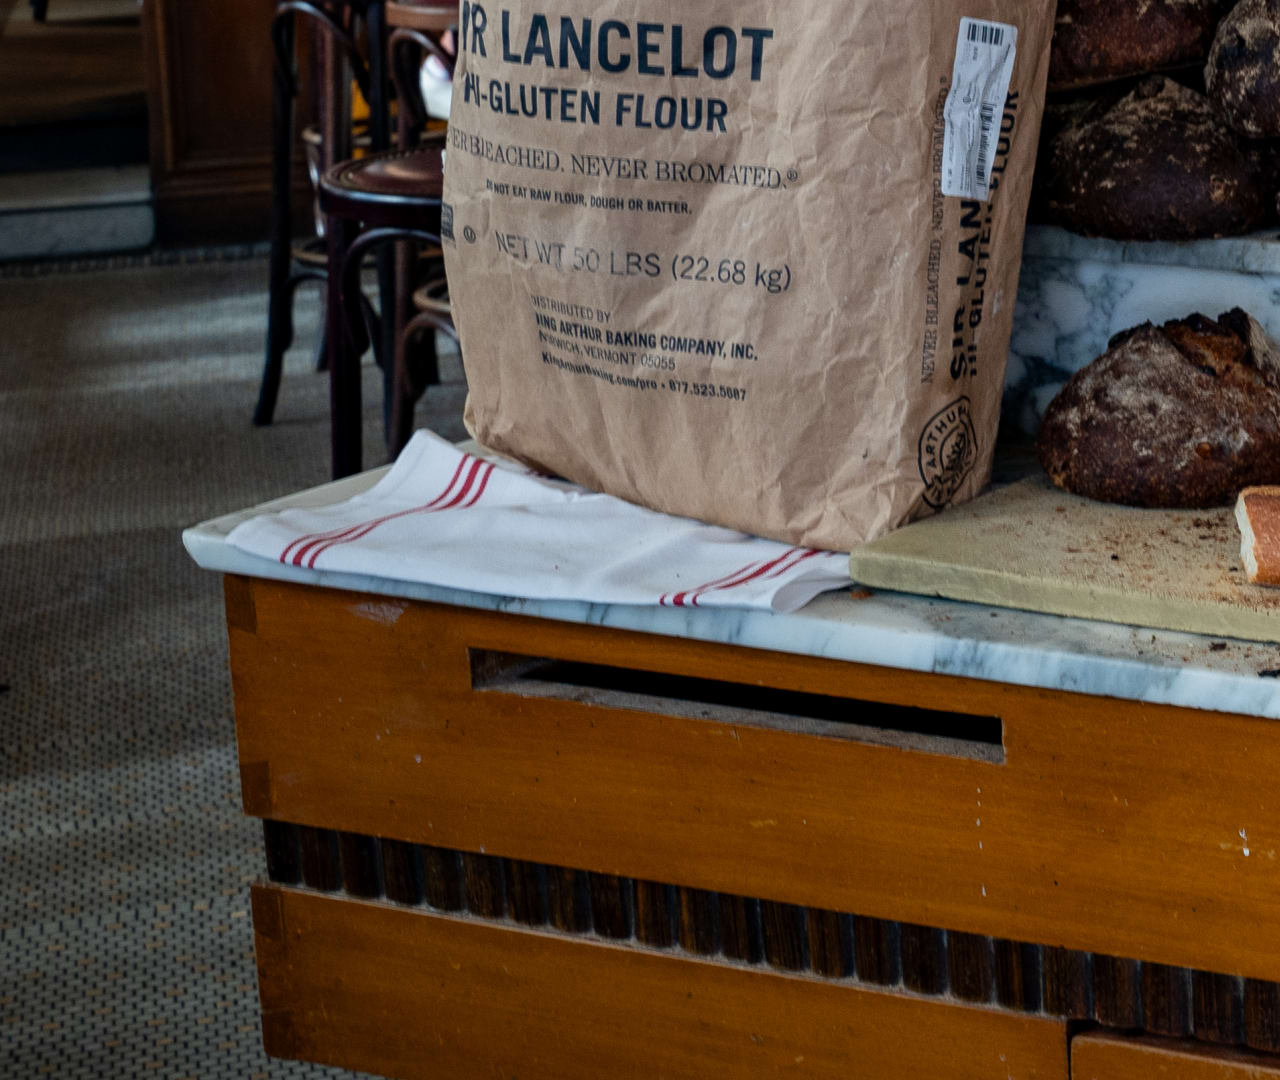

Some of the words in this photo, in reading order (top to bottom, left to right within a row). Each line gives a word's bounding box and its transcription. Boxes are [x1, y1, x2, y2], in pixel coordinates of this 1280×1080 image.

[502, 7, 774, 83] LANCELOT
[615, 92, 729, 134] FLOUR
[571, 153, 649, 180] NEVER
[494, 181, 510, 196] NOT
[513, 184, 528, 199] EAT
[530, 187, 551, 202] RAW
[590, 195, 625, 211] DOUGH
[628, 197, 643, 211] OR
[646, 199, 693, 215] BATTER.
[495, 231, 529, 261] NET
[534, 238, 566, 271] WT
[574, 247, 600, 273] 50
[609, 250, 662, 278] LBS
[671, 253, 746, 286] (22.68
[755, 262, 792, 294] kg)
[596, 309, 611, 324] BY
[559, 319, 602, 343] ARTHUR
[605, 329, 657, 350] BAKING
[660, 333, 727, 359] COMPANY,
[731, 342, 759, 362] INC.
[583, 344, 637, 366] VERMONT
[640, 352, 676, 371] 05055
[921, 329, 939, 385] NEVER
